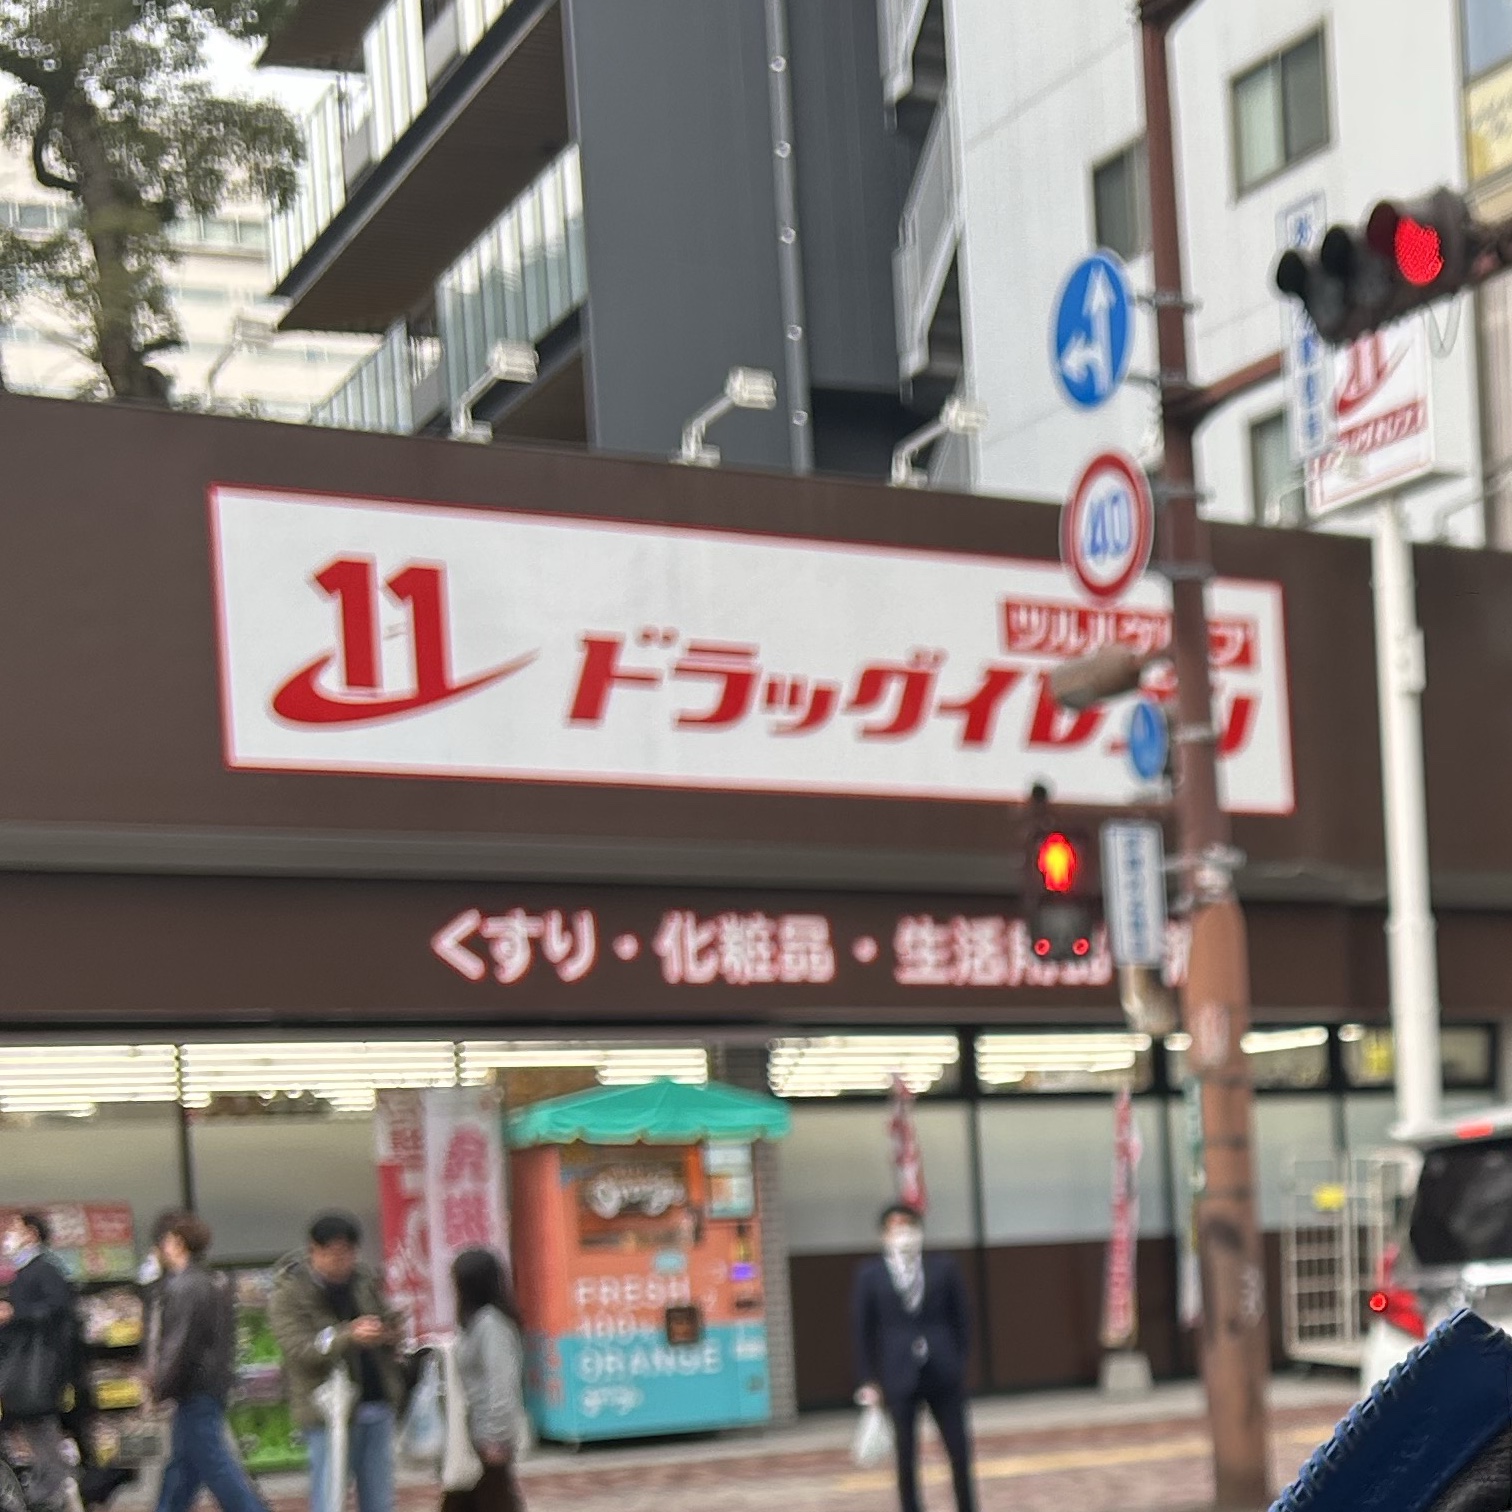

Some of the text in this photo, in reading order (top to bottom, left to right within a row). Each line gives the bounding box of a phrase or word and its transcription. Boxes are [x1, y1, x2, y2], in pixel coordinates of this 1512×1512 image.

[1085, 488, 1133, 560] 40
[566, 627, 1256, 760] ドラッグイレ
[574, 1275, 692, 1308] FRESH
[577, 1338, 723, 1382] ORANGE
